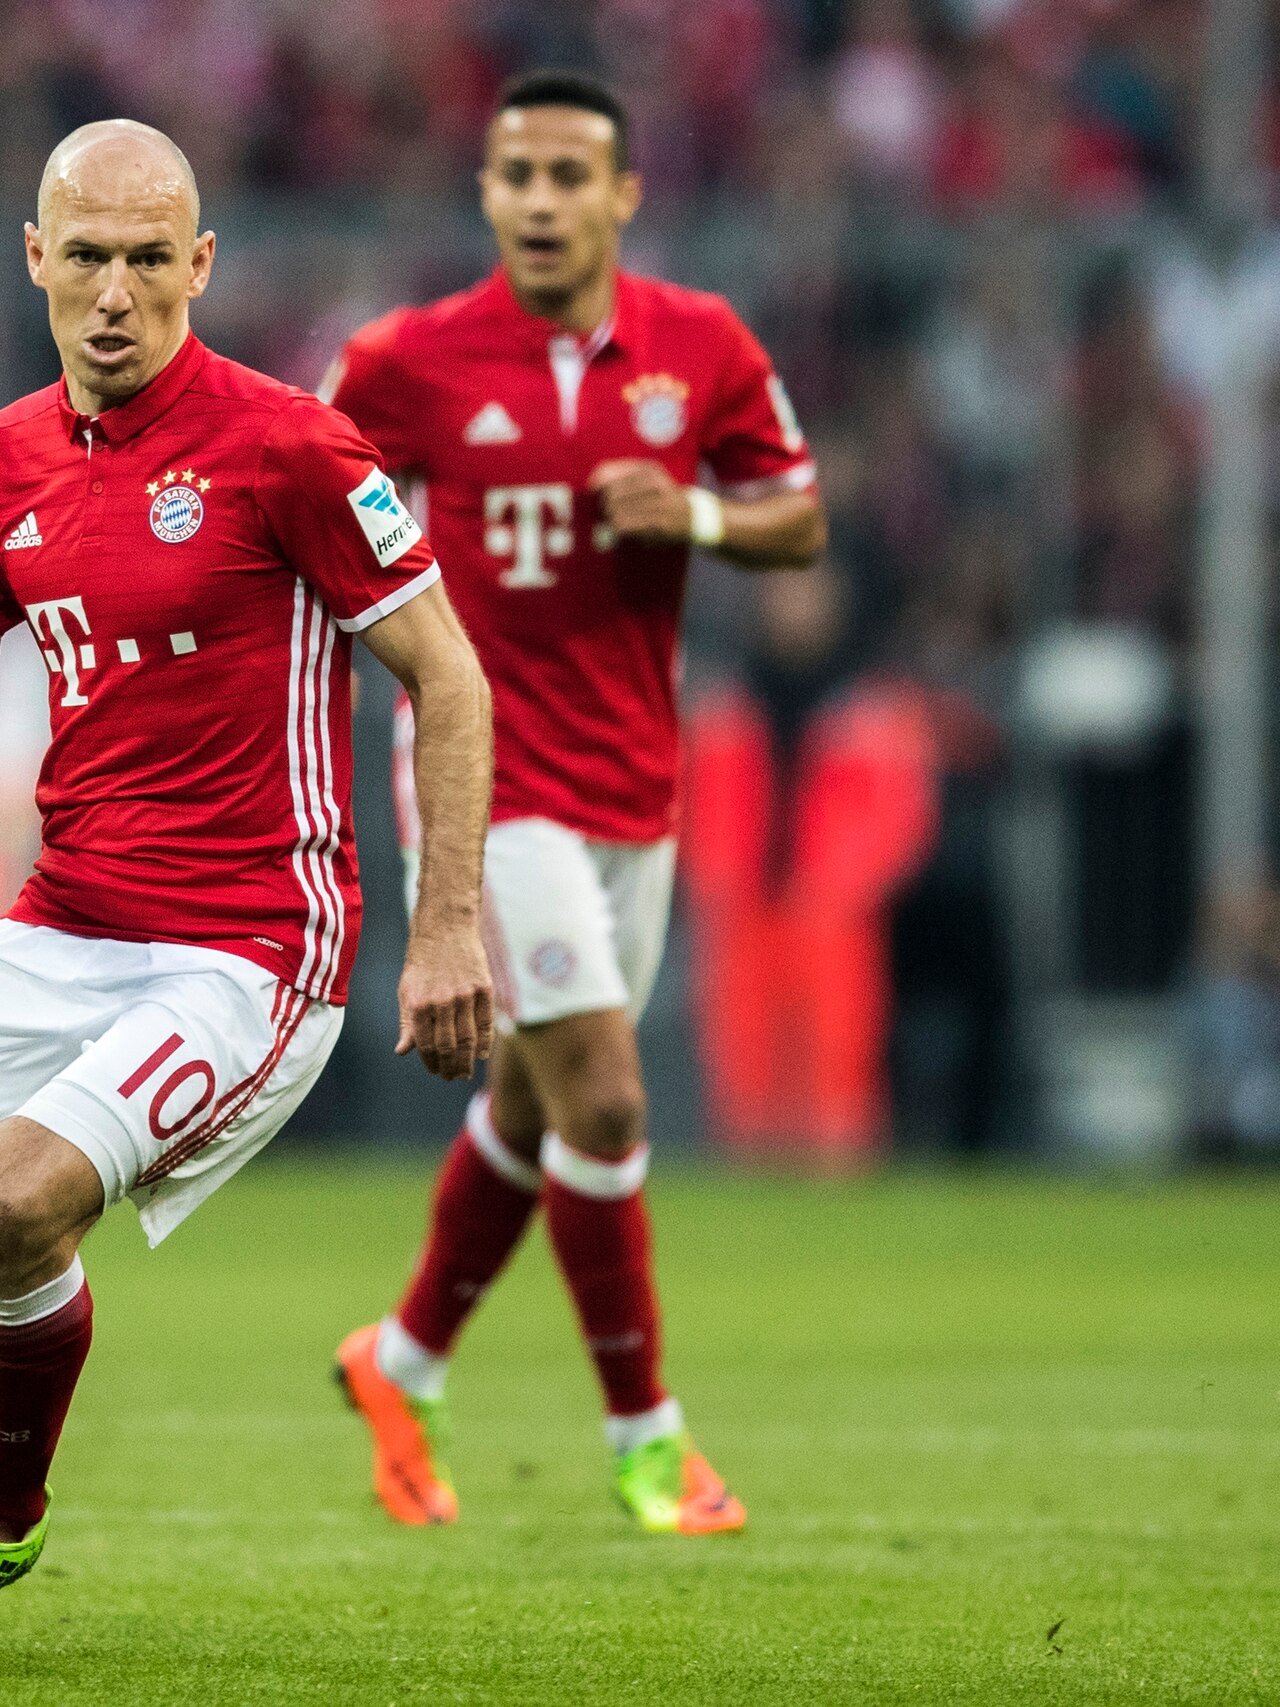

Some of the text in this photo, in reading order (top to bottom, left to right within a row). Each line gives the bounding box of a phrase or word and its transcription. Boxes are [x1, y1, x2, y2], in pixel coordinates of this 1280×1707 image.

[164, 489, 199, 511] BAYERN
[4, 534, 43, 551] adidas
[117, 1032, 216, 1141] 10
